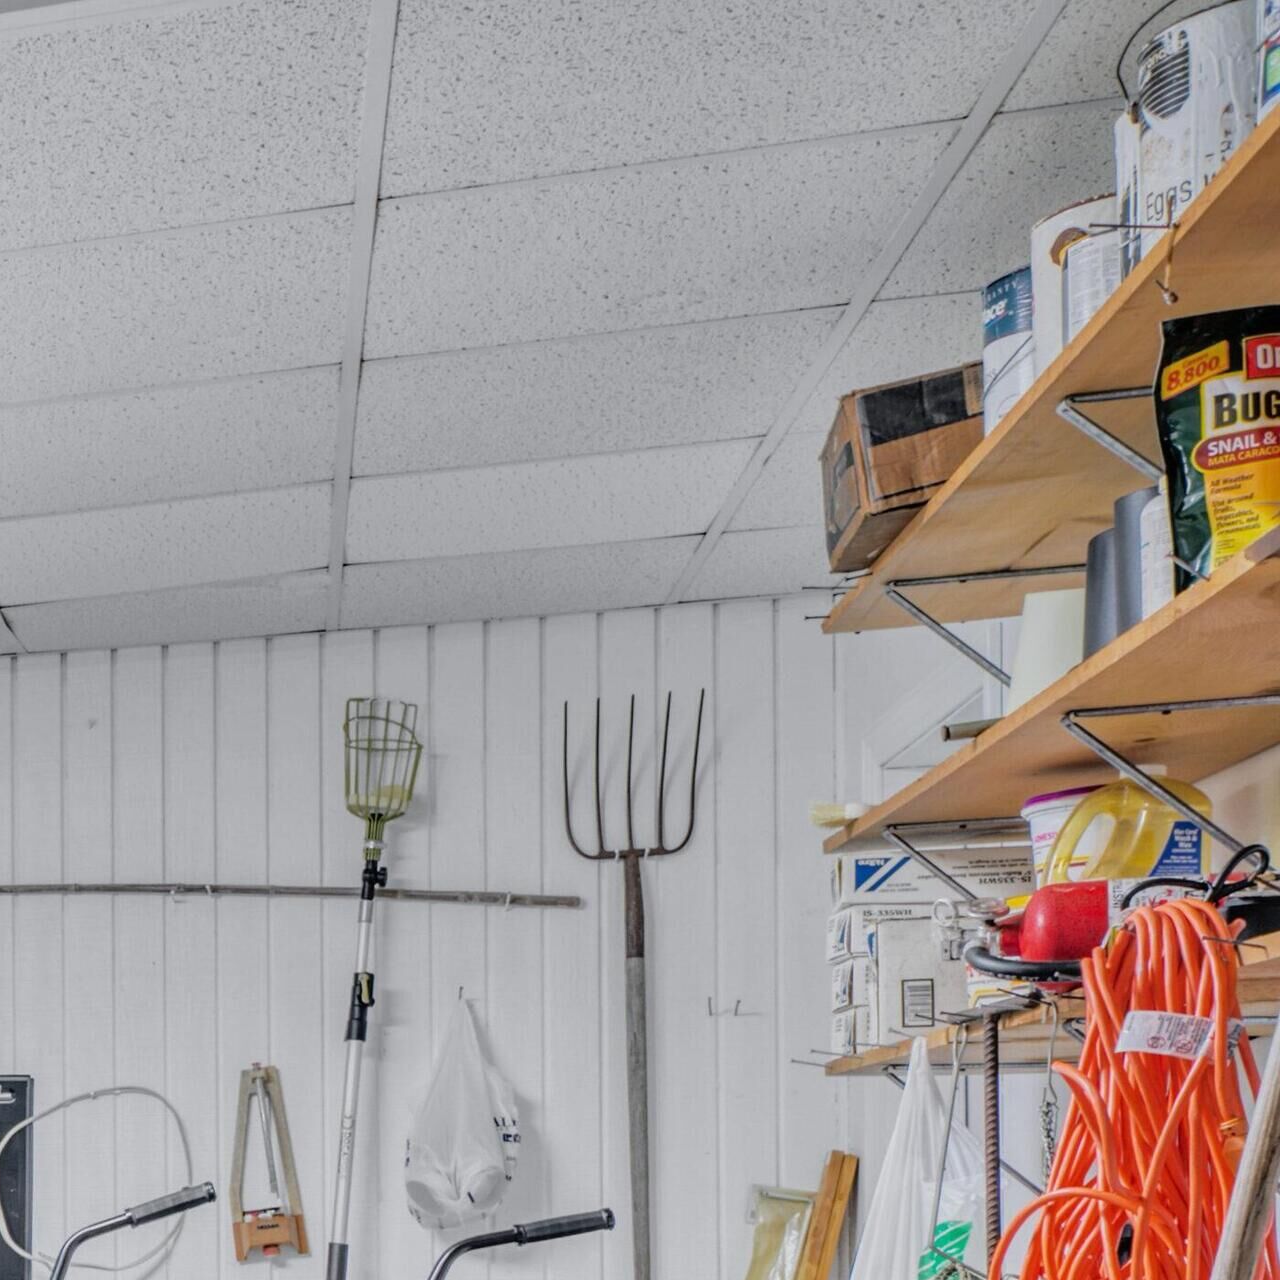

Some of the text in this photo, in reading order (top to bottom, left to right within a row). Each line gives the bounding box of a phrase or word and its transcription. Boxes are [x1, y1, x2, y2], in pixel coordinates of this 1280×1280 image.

[1146, 180, 1193, 222] Eggs
[1213, 390, 1280, 428] BUG
[1208, 431, 1277, 456] SNAIL &
[1208, 453, 1236, 466] MATA
